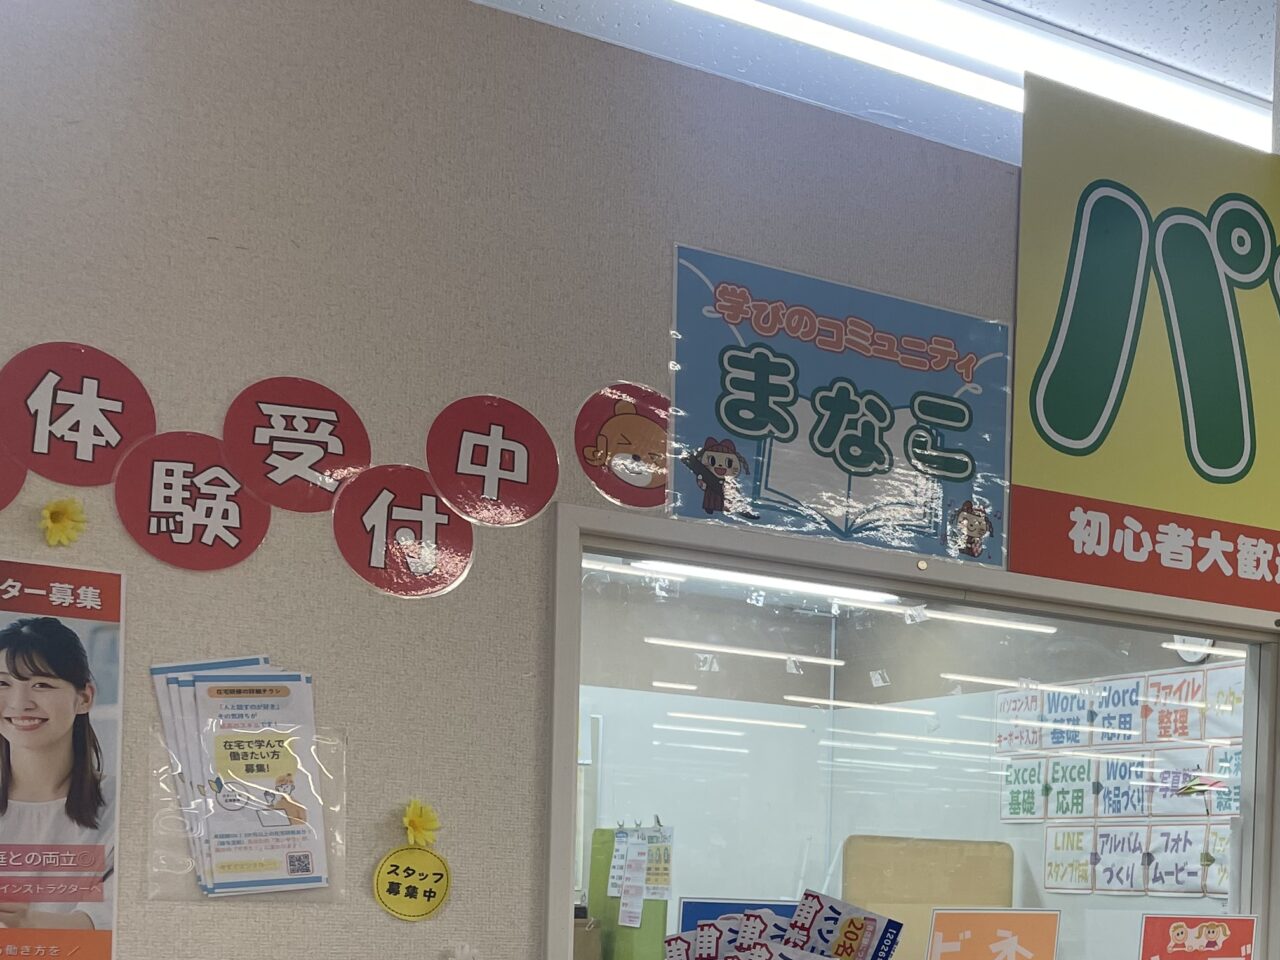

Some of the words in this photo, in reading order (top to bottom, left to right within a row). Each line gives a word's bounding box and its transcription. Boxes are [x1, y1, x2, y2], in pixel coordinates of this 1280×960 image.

[715, 282, 977, 383] 学びのコミュニティ
[716, 343, 976, 480] まなこ
[223, 738, 286, 751] 在宅で学んで
[229, 749, 281, 762] 働きたい方
[244, 763, 271, 774] 募集!
[1005, 760, 1042, 784] Excel
[1051, 759, 1092, 784] Excel
[1106, 757, 1145, 781] Word
[386, 863, 444, 884] スタッフ
[385, 880, 437, 903] 募集中
